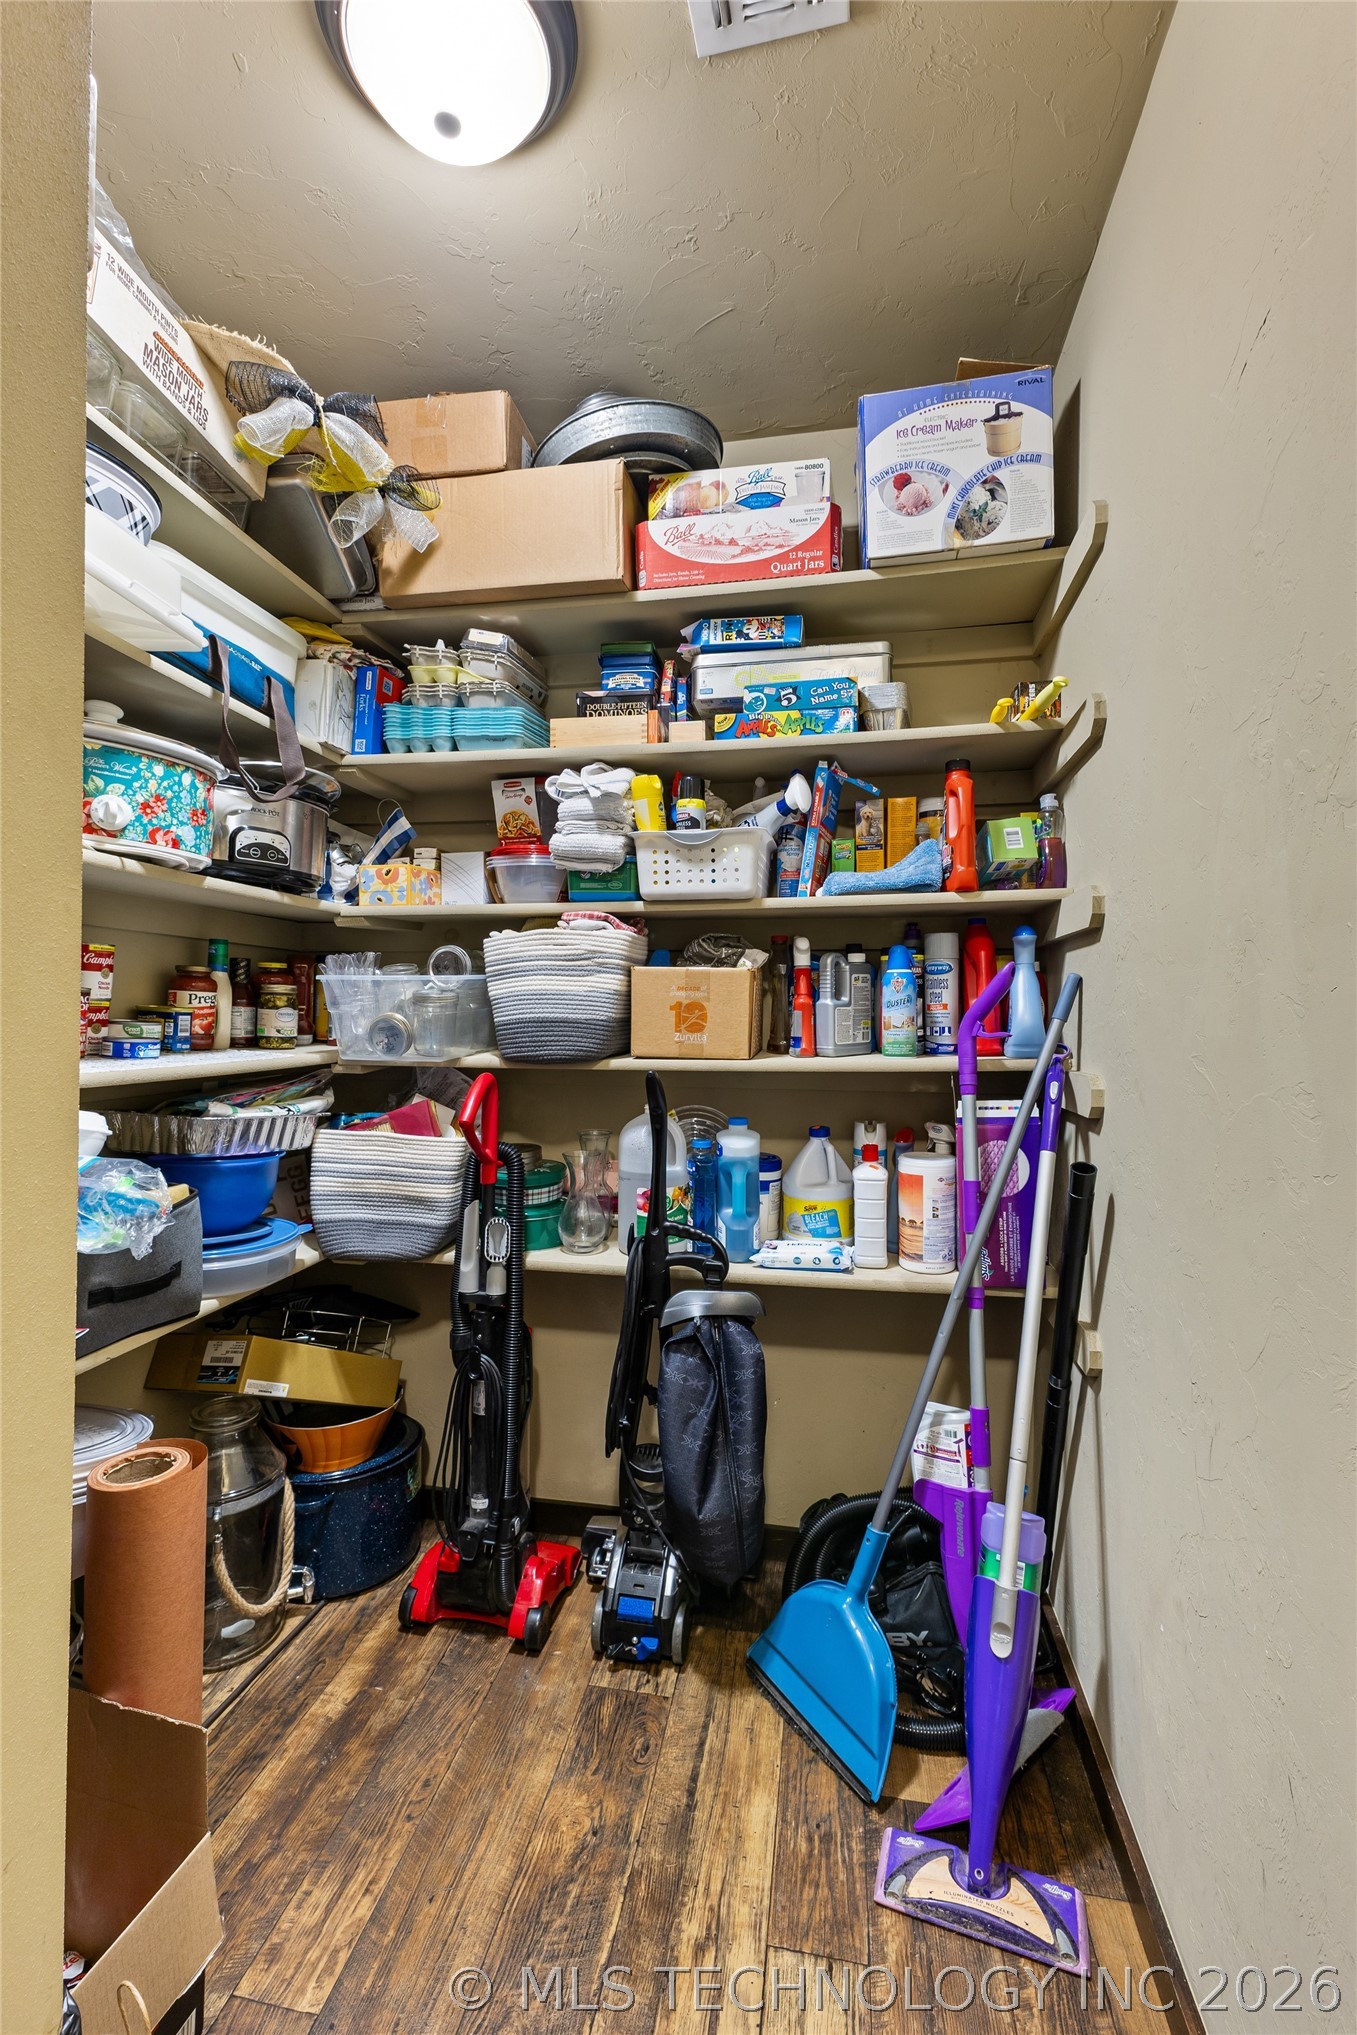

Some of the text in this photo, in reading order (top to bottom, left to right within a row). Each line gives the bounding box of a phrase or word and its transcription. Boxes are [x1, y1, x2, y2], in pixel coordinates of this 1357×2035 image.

[105, 260, 117, 275] FOR
[107, 252, 179, 338] 12 WIDE MOUTH PINTS
[153, 340, 174, 371] WIDE
[176, 365, 203, 399] MOUTH
[143, 342, 182, 394] MASON
[183, 387, 209, 423] JARS
[1017, 377, 1045, 387] RIVAL
[142, 359, 207, 431] WITH BANDS & LIDS
[897, 390, 1014, 417] AT HOME ENTERTAINING
[924, 414, 949, 423] ELECTRIC
[896, 417, 978, 440] Ice Cream Maker
[804, 462, 824, 470] 80800
[869, 460, 951, 487] STRAWBERRY ICE CREAM
[748, 467, 773, 486] Ball
[947, 454, 1042, 520] MINT CHOCOLATE CHIP ICE CREAM
[664, 522, 697, 546] Ball
[798, 550, 823, 558] Regular
[771, 559, 824, 573] Quart Jars
[810, 681, 849, 695] Can You
[810, 689, 854, 705] Name 5?
[586, 702, 647, 711] DOUBLE-FIFTEEN
[586, 708, 648, 718] DOMINOES
[749, 711, 763, 720] Big
[735, 718, 778, 738] APPLES
[781, 714, 825, 736] APPLES
[250, 806, 280, 817] ROCK-POT
[83, 952, 114, 966] Campb
[188, 993, 217, 1007] Preg
[887, 996, 911, 1008] DUSTER
[930, 991, 942, 1003] steel
[669, 1000, 707, 1033] 10
[674, 1033, 706, 1041] Zurvita
[805, 1212, 828, 1223] BLEACH
[981, 1246, 992, 1281] Swiffer
[954, 1498, 964, 1557] Rejuvenate
[890, 1630, 933, 1647] BY.
[896, 1836, 924, 1848] Swiffer
[1042, 1883, 1073, 1900] Swiffer
[943, 1890, 1014, 1917] ILLUMINATED NOZZLES
